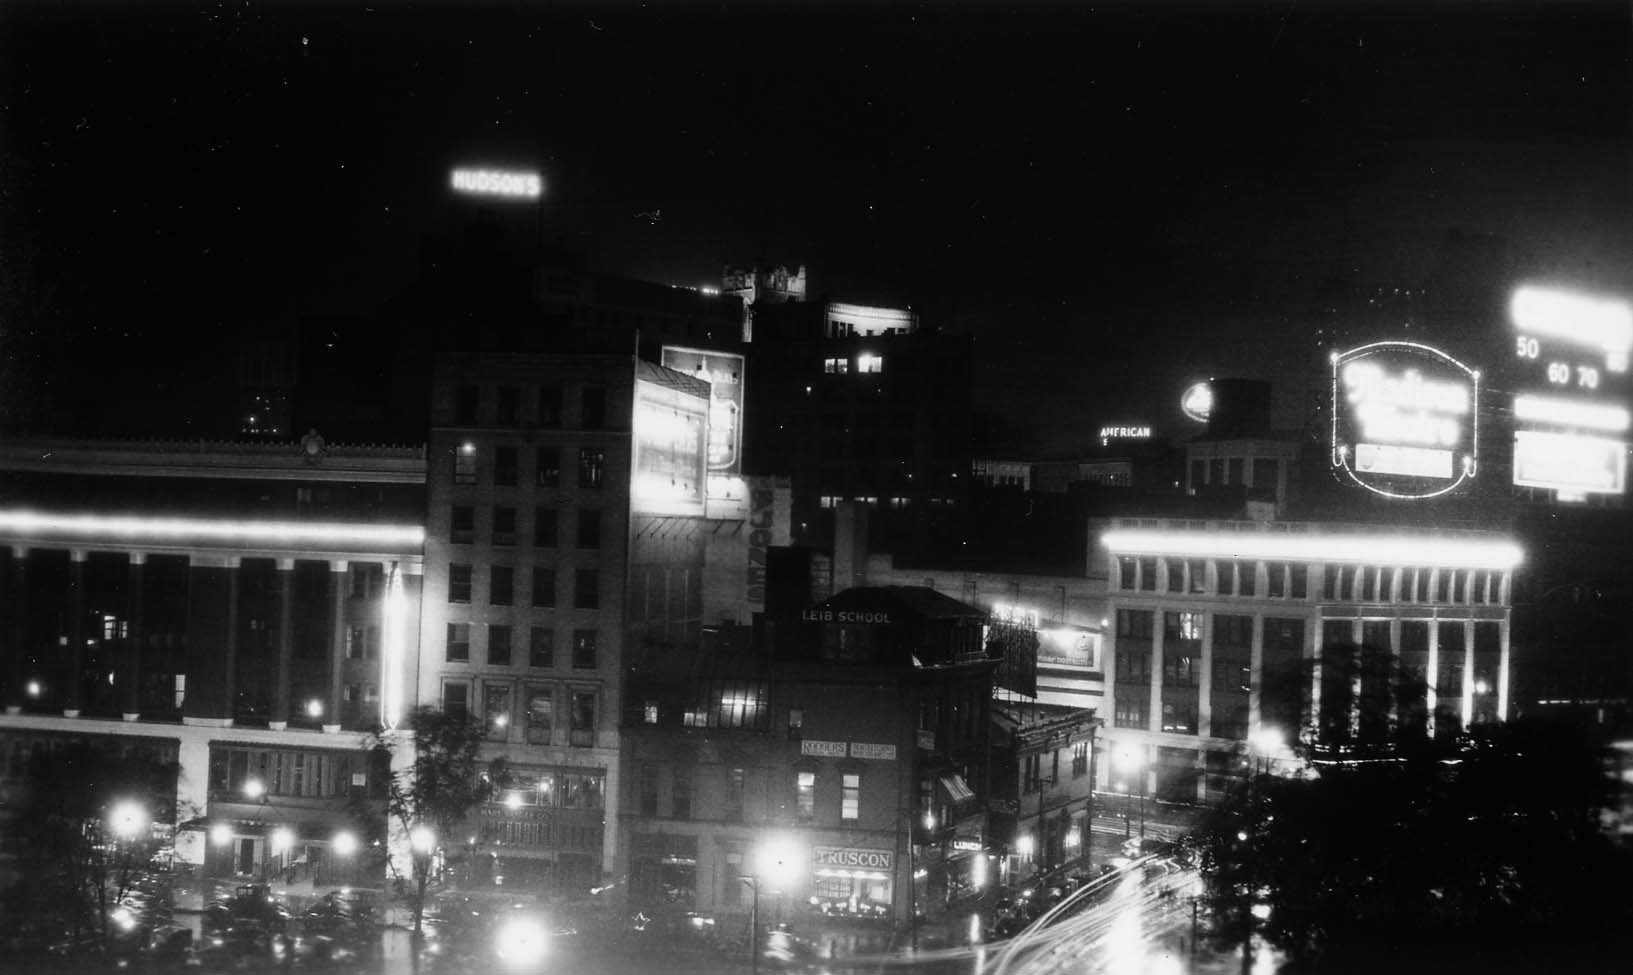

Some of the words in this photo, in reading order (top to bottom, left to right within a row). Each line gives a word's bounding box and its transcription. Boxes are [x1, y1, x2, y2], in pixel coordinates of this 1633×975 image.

[453, 170, 540, 196] HUDSON'S
[1516, 336, 1539, 359] 50
[1548, 362, 1570, 384] 60
[1577, 366, 1598, 388] 70
[802, 610, 833, 622] LEIB
[838, 611, 892, 624] SCHOOL
[816, 849, 890, 867] TRUSCON
